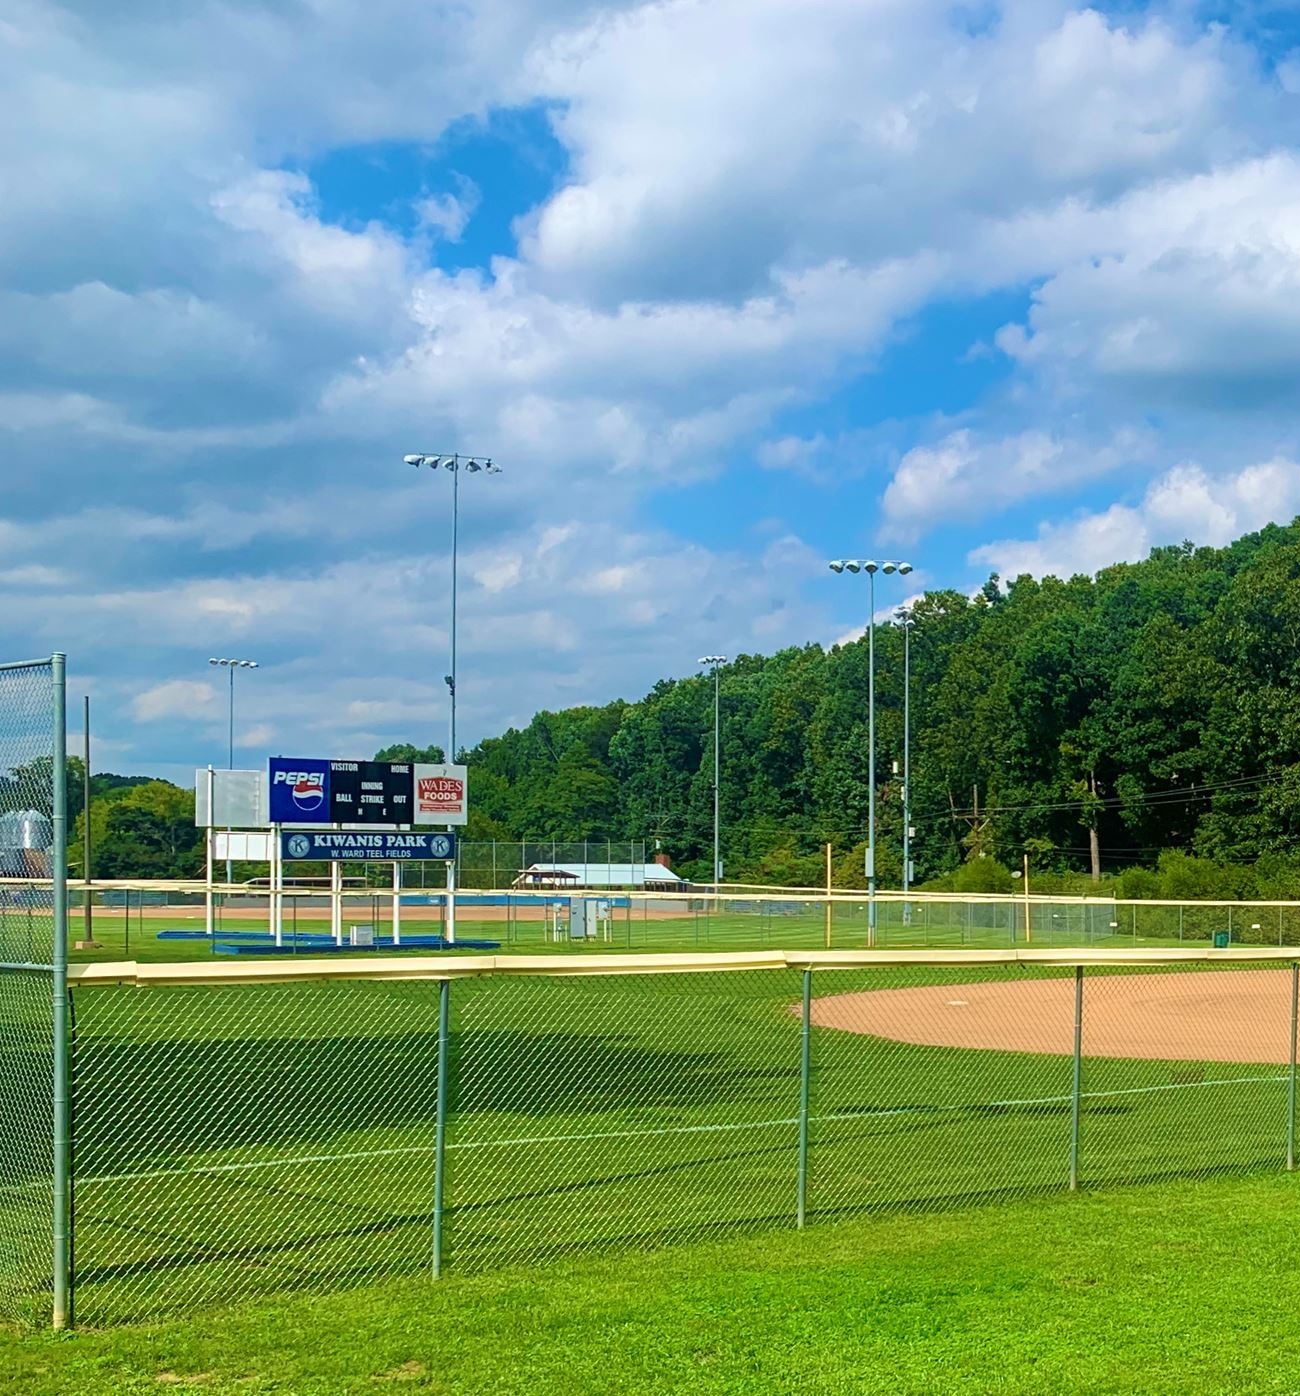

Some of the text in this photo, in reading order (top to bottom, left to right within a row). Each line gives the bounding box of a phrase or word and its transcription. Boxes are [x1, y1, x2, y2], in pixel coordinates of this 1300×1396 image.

[331, 762, 359, 772] VISITOR
[391, 765, 409, 774] HOME
[273, 771, 325, 786] PEPSI
[361, 781, 383, 791] INNING
[420, 780, 462, 792] WADES
[336, 793, 353, 803] BALL
[360, 794, 384, 804] STRIKE
[393, 795, 407, 804] OUT
[424, 792, 457, 800] FOODS
[314, 835, 427, 848] KIWANIS PARK
[342, 850, 365, 858] WARD
[366, 850, 384, 858] TEEL
[386, 850, 411, 858] FIELDS
